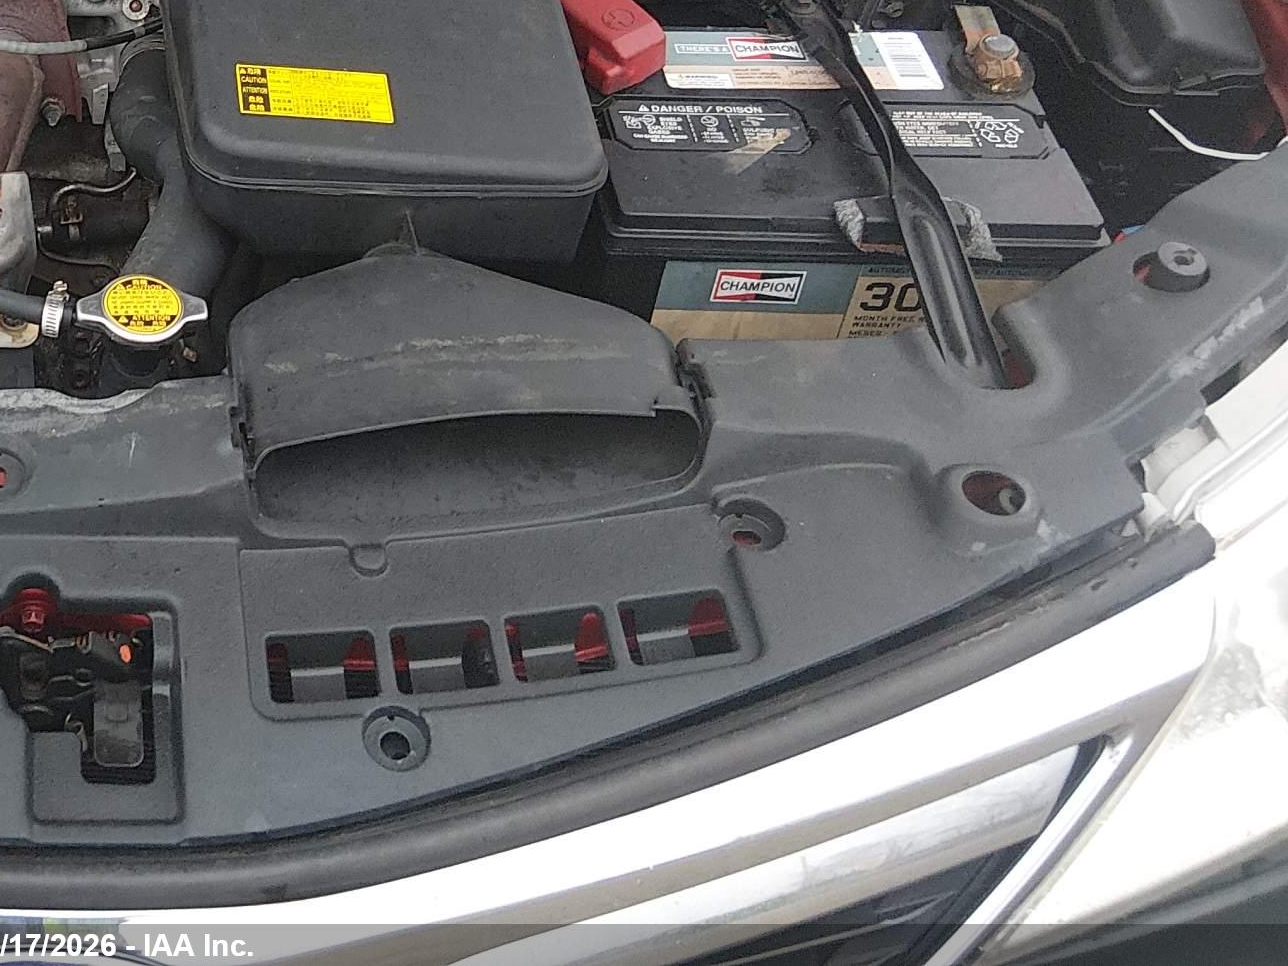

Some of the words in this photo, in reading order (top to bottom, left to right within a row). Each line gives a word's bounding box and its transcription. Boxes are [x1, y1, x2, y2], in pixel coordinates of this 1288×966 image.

[735, 44, 800, 54] CHAMPION
[241, 75, 267, 84] CAUTION
[651, 105, 703, 113] DANGER
[715, 106, 763, 114] POISON
[720, 280, 796, 293] CHAMPION
[860, 282, 922, 312] 30
[890, 315, 916, 323] FREE
